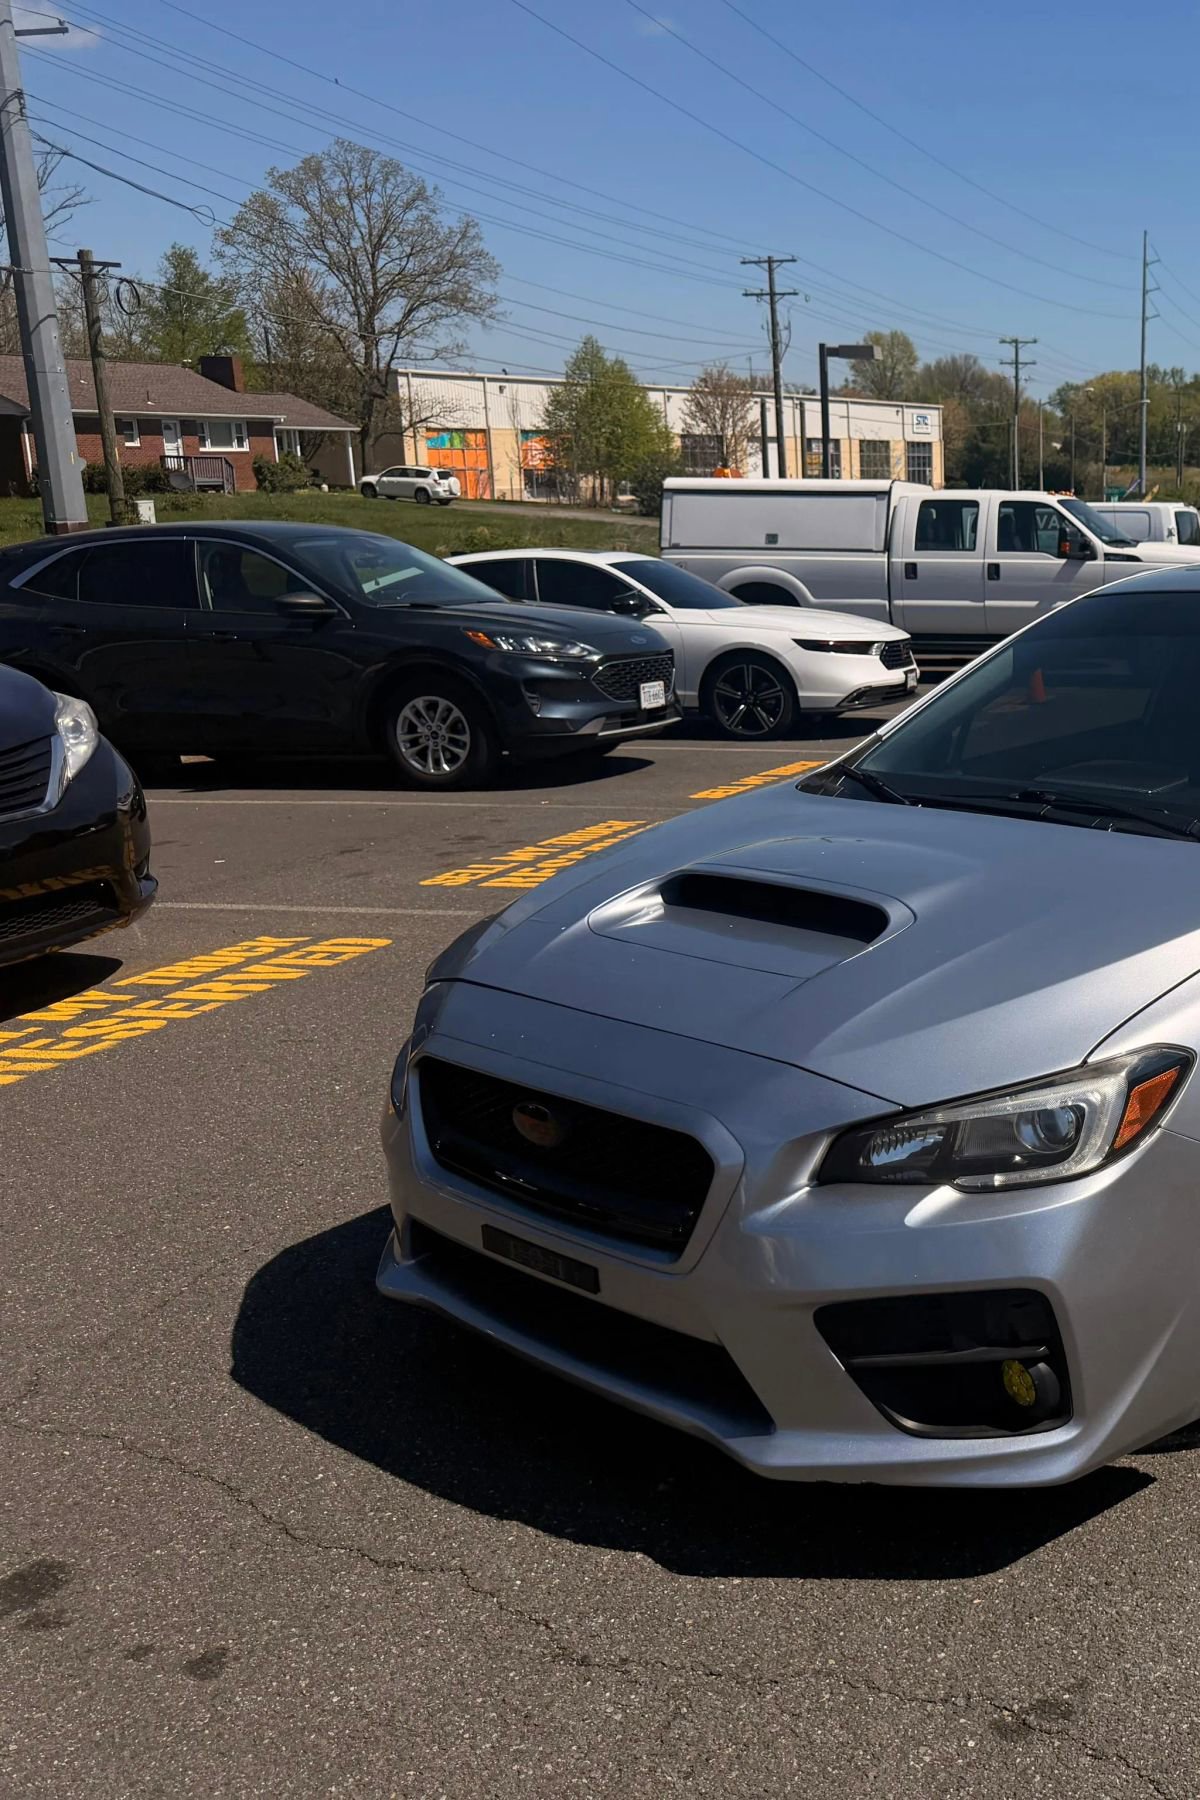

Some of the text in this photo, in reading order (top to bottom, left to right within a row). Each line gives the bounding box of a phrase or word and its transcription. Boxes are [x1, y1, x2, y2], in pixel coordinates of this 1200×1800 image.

[418, 820, 648, 887] SELL MY TRUCK
[16, 936, 312, 1021] MY TRUCK
